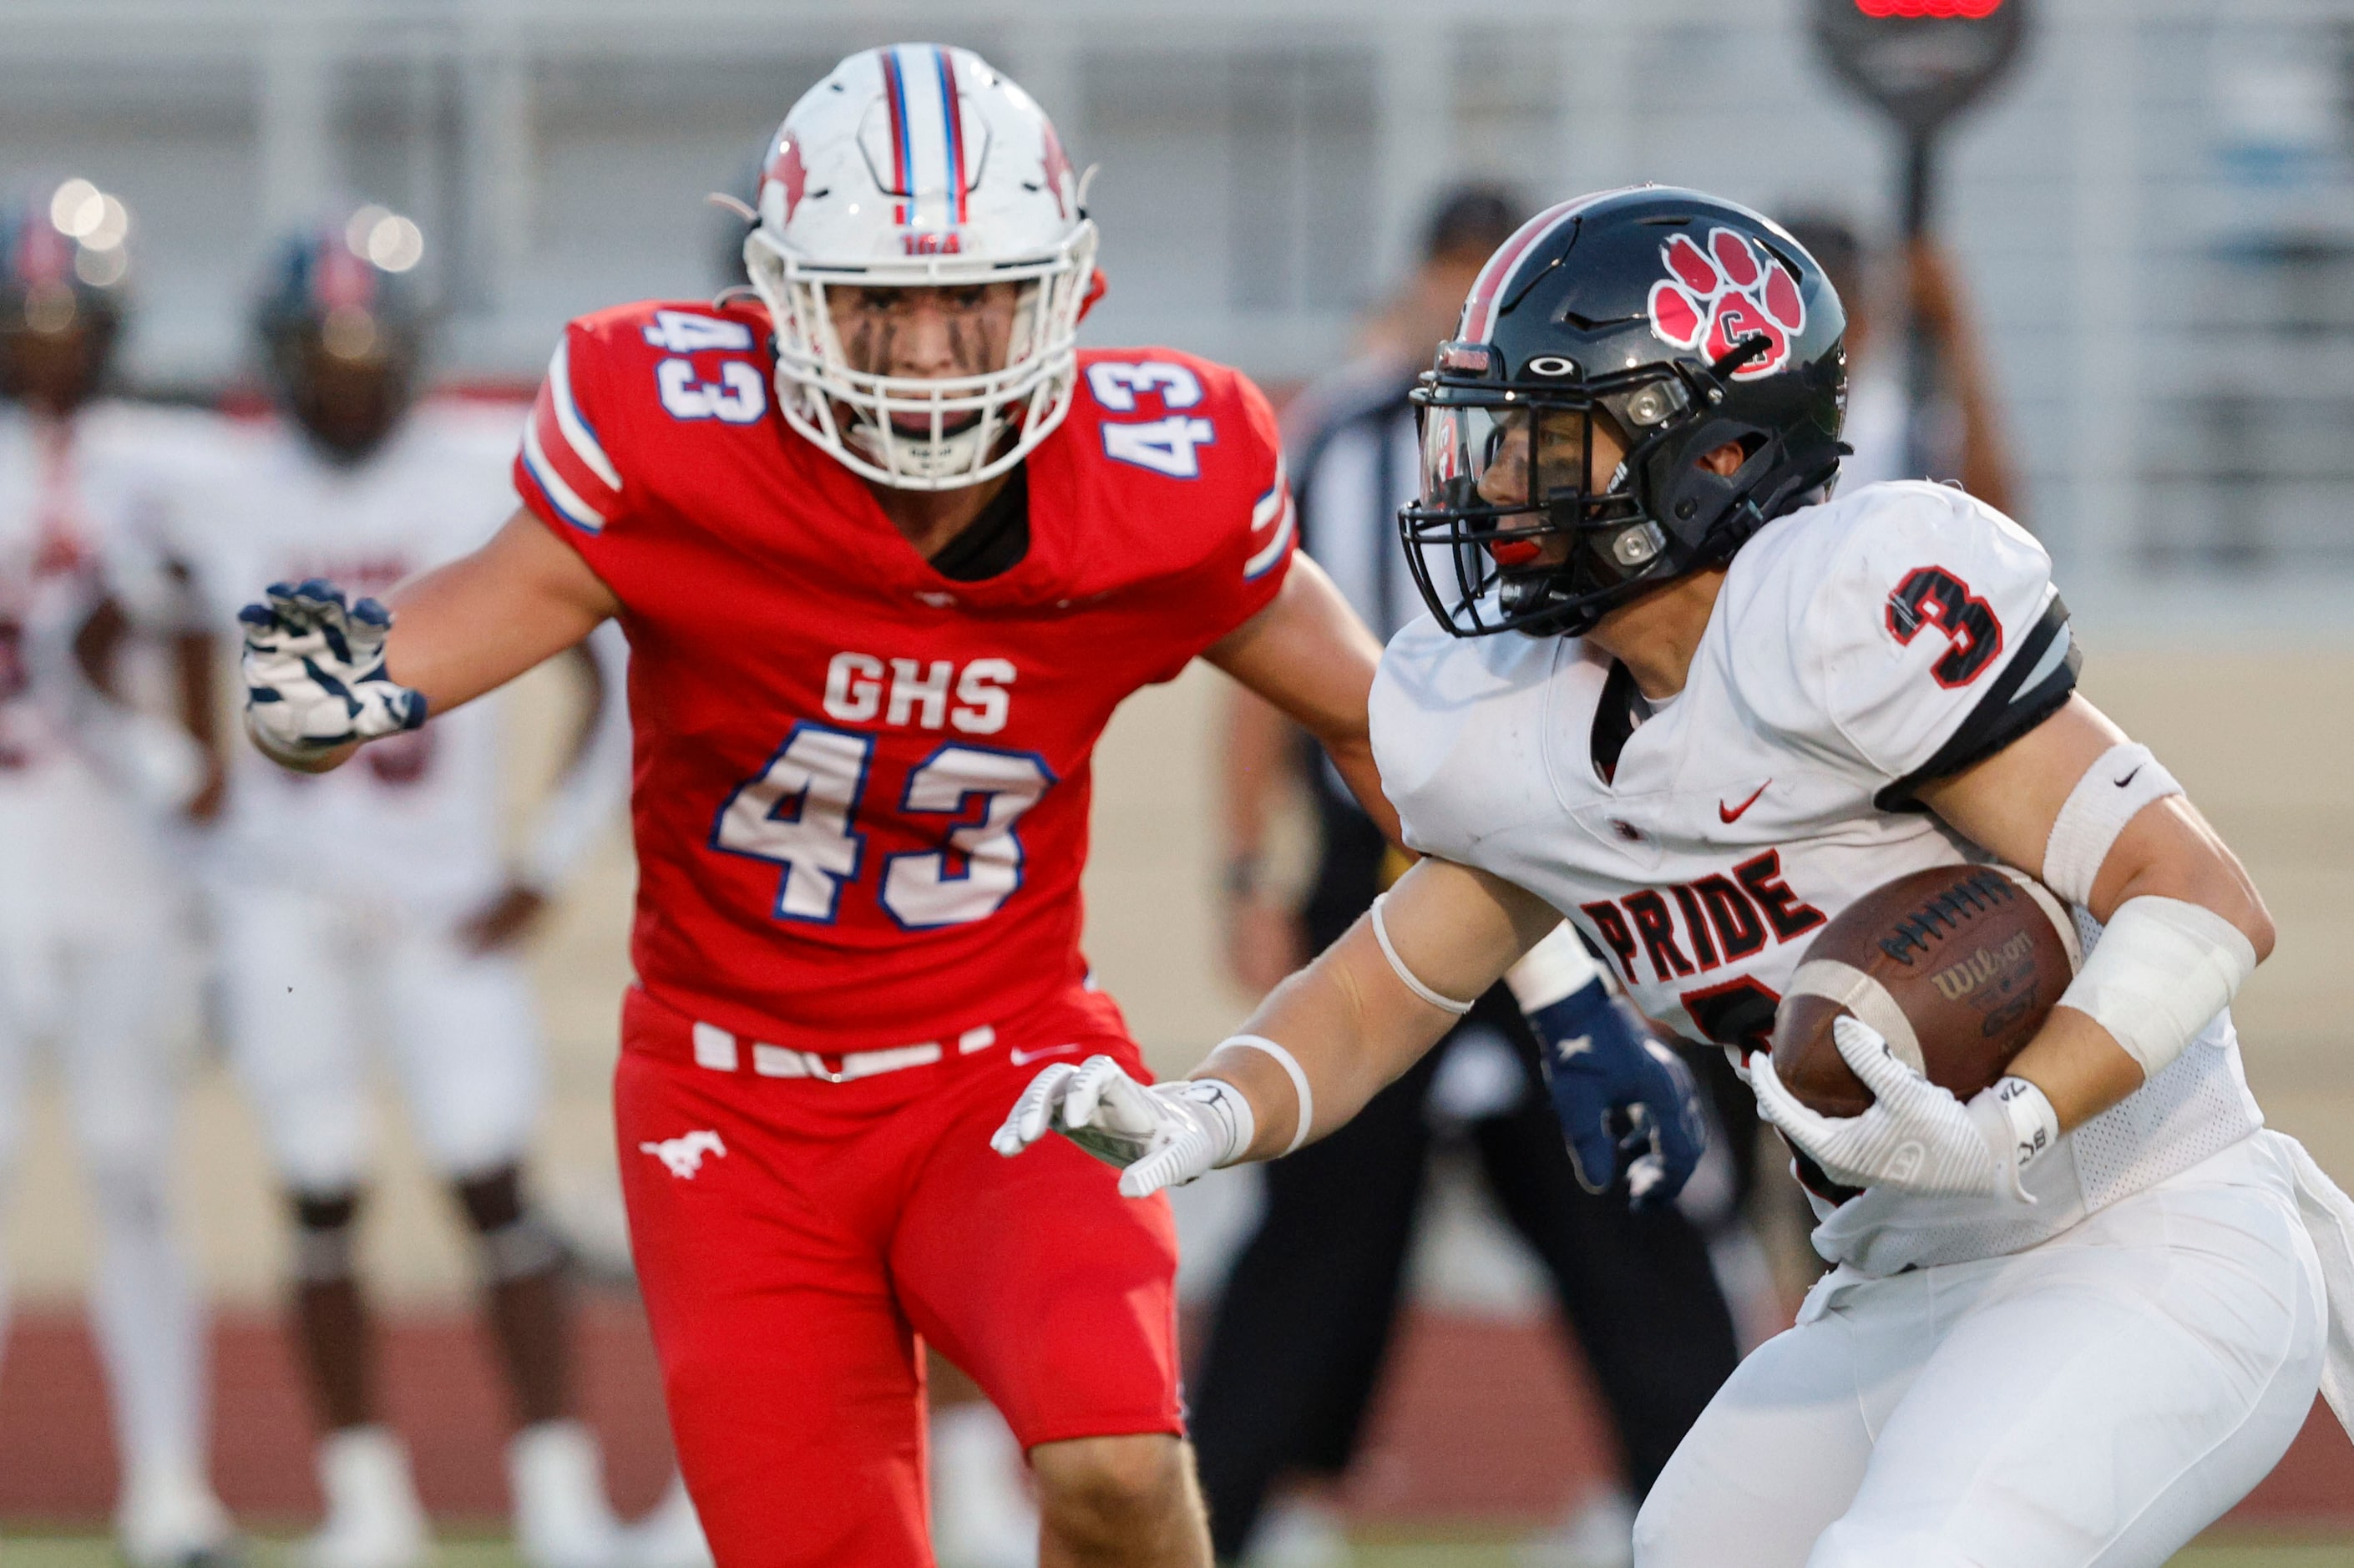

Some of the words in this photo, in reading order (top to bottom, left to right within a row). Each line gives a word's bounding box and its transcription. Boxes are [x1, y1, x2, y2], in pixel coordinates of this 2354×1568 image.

[642, 310, 767, 424] 43
[1086, 361, 1215, 479] 43
[1885, 564, 2004, 690] 3
[823, 650, 1018, 735] GHS
[706, 718, 1060, 933] 43
[1579, 847, 1828, 985] PRIDE
[1931, 929, 2034, 1001] Wilson
